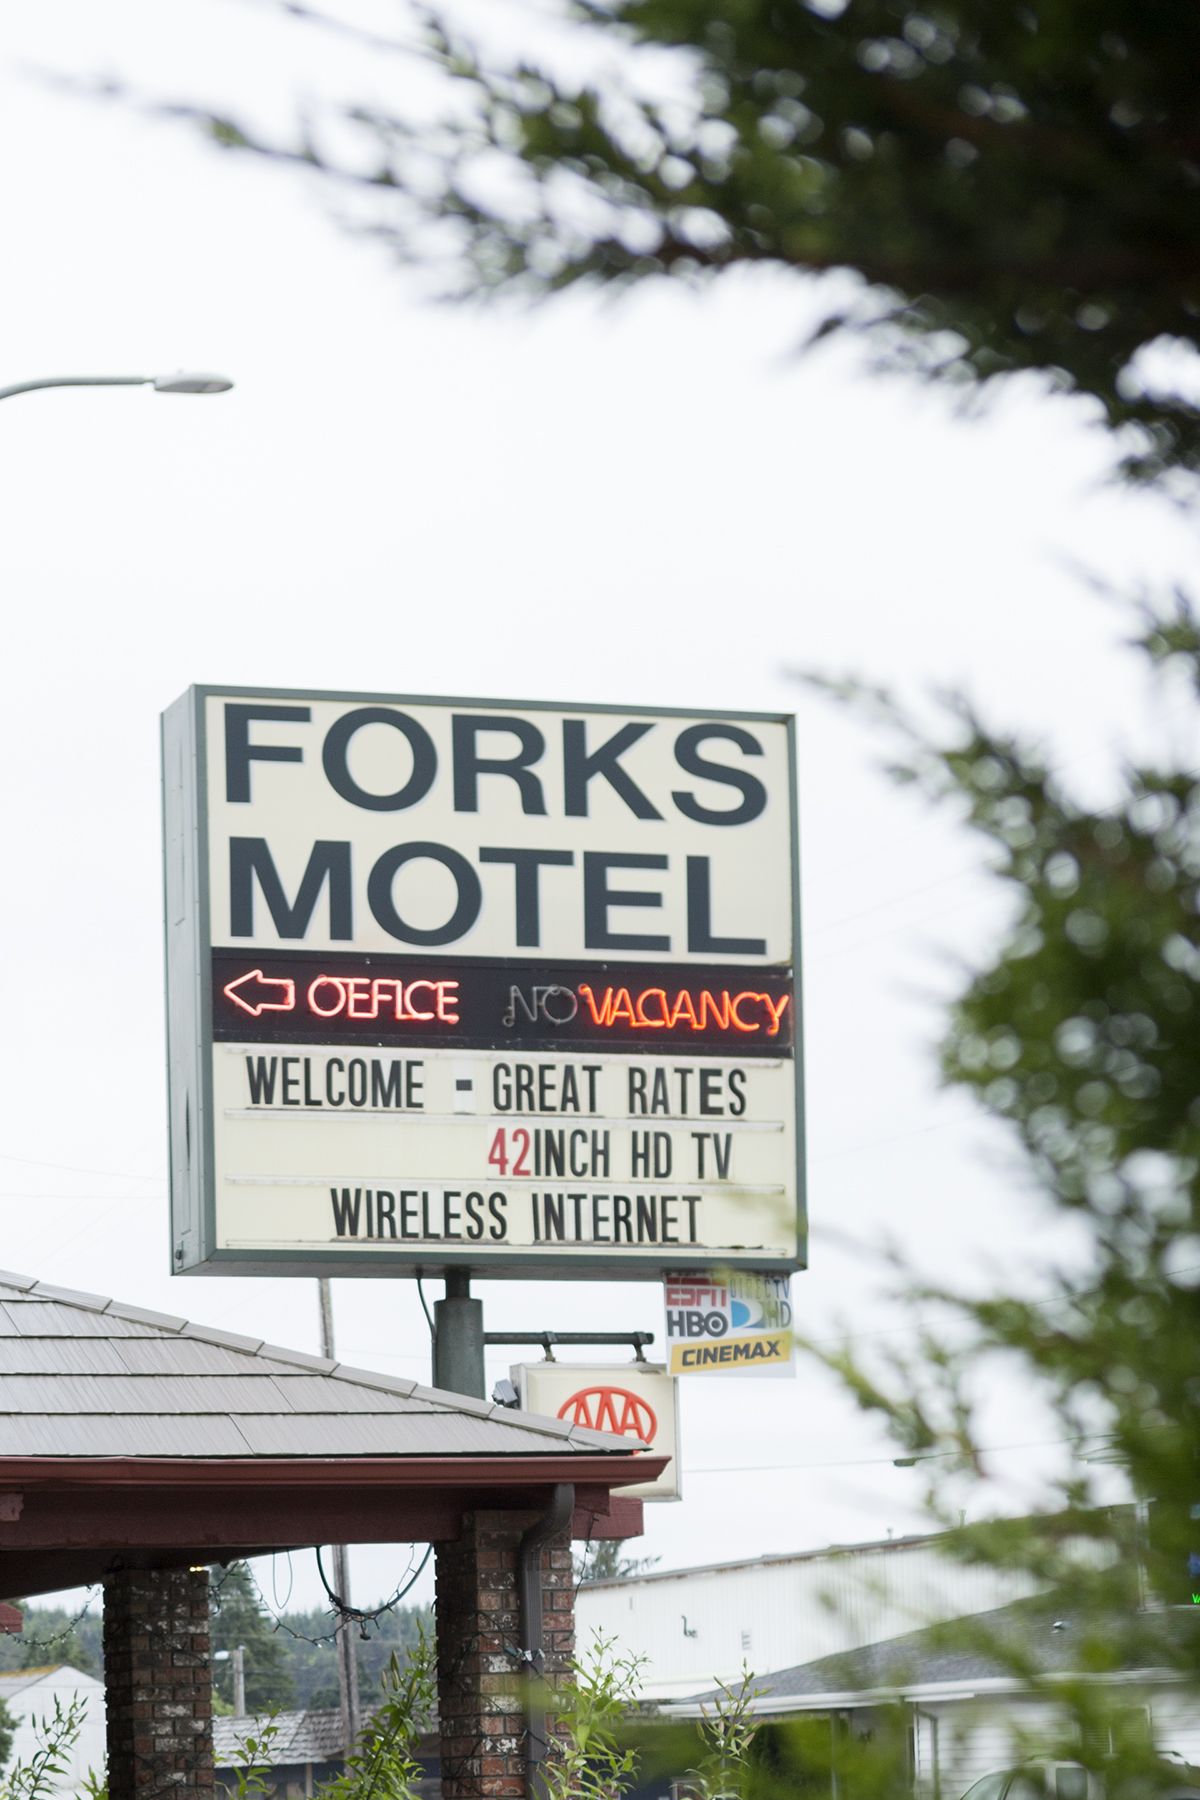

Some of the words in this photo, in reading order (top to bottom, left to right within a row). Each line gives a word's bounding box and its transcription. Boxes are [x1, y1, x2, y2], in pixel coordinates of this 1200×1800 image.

[223, 702, 769, 827] FORKS
[228, 835, 768, 956] MOTEL
[307, 975, 460, 1024] OFFICE
[503, 984, 578, 1027] NO
[578, 983, 790, 1037] VACANCY
[246, 1055, 425, 1110] WELCOME
[492, 1062, 603, 1115] GREAT
[628, 1066, 747, 1116] RATES
[487, 1127, 611, 1179] 42INCH
[631, 1131, 673, 1180] HD
[691, 1133, 733, 1181] TV
[330, 1187, 509, 1241] WIRELESS
[532, 1192, 703, 1244] INTERNET
[666, 1277, 726, 1307] ESPN
[666, 1310, 729, 1337] HBO
[682, 1340, 781, 1367] CINEMAX
[566, 1389, 650, 1441] AAA
